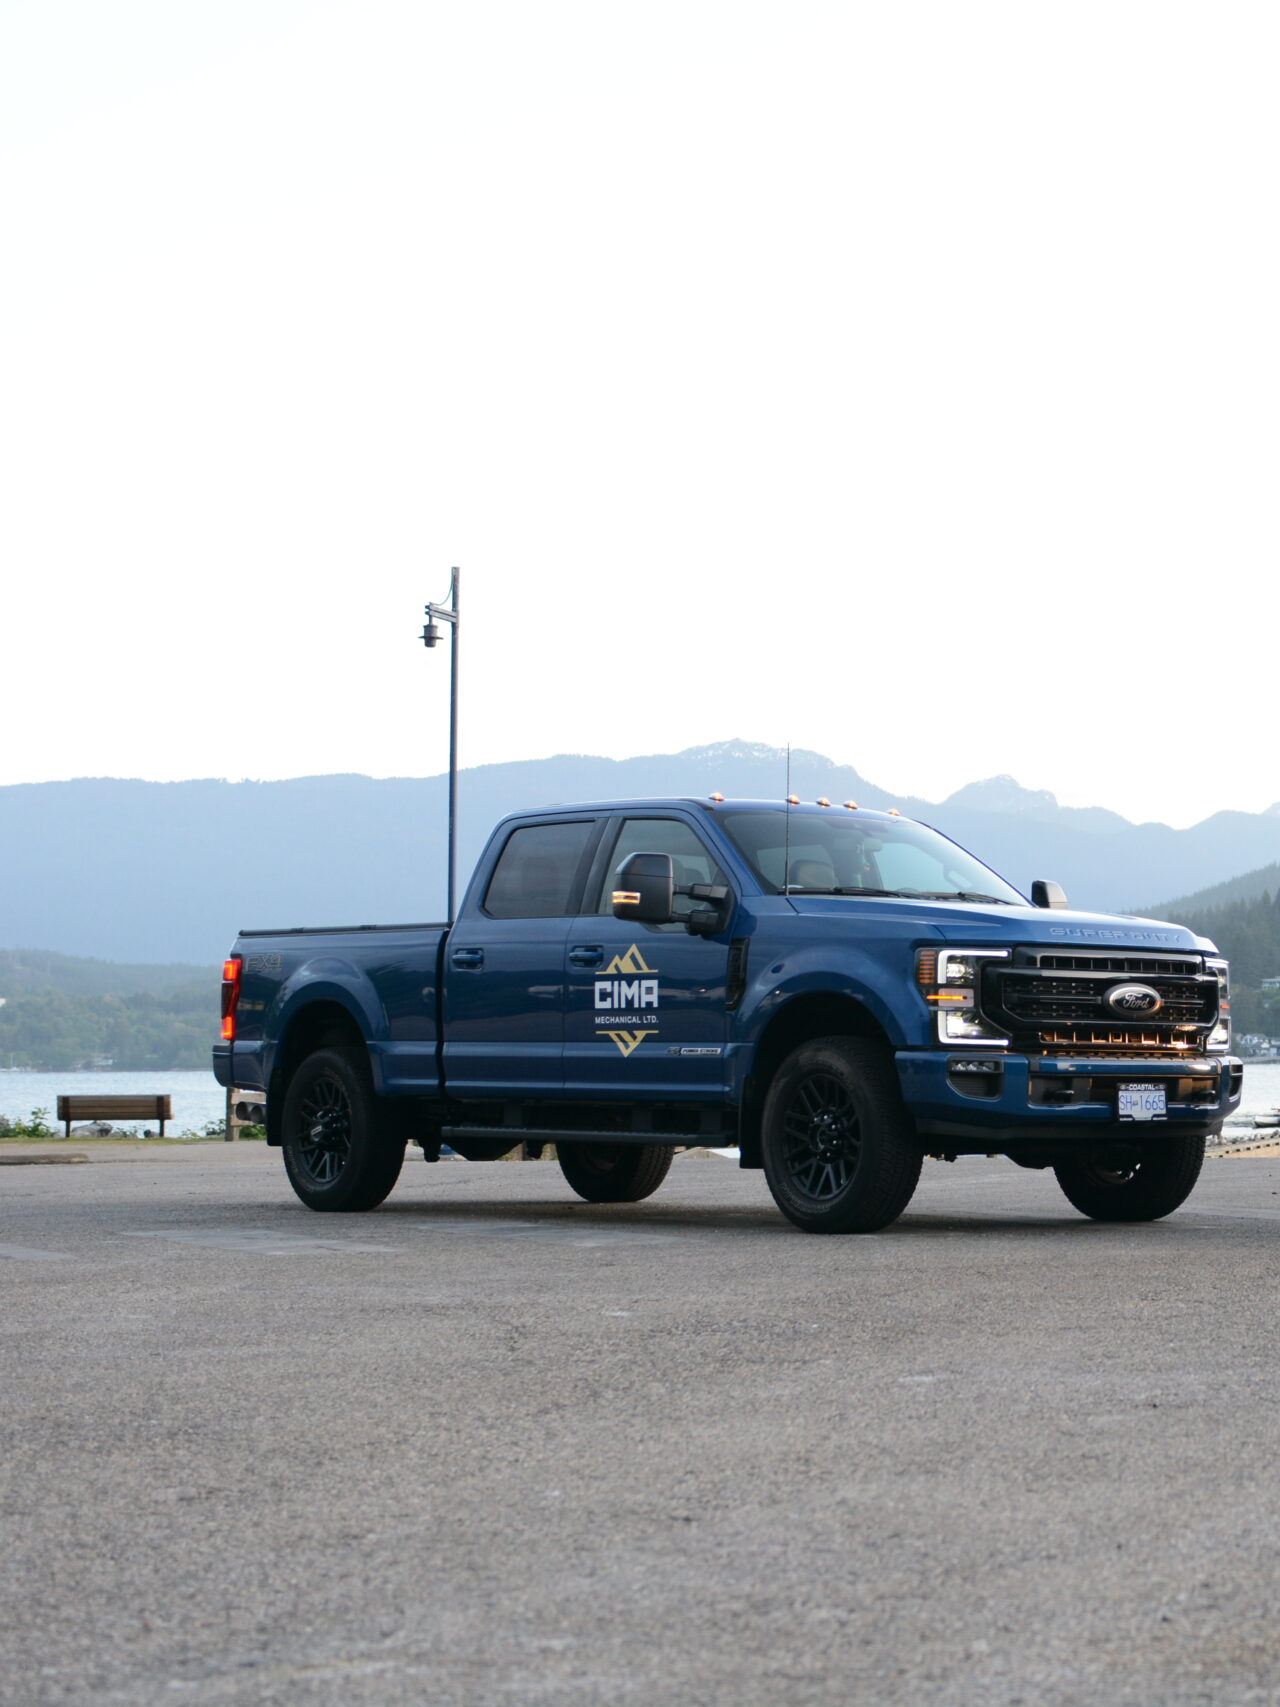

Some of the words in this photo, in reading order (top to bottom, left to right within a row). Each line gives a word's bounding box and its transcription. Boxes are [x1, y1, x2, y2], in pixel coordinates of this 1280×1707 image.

[1049, 927, 1125, 940] SUPER
[594, 979, 659, 1009] CIMA
[1122, 992, 1149, 1009] Ford
[595, 1015, 641, 1024] MECHANICAL
[643, 1015, 659, 1023] LTD.
